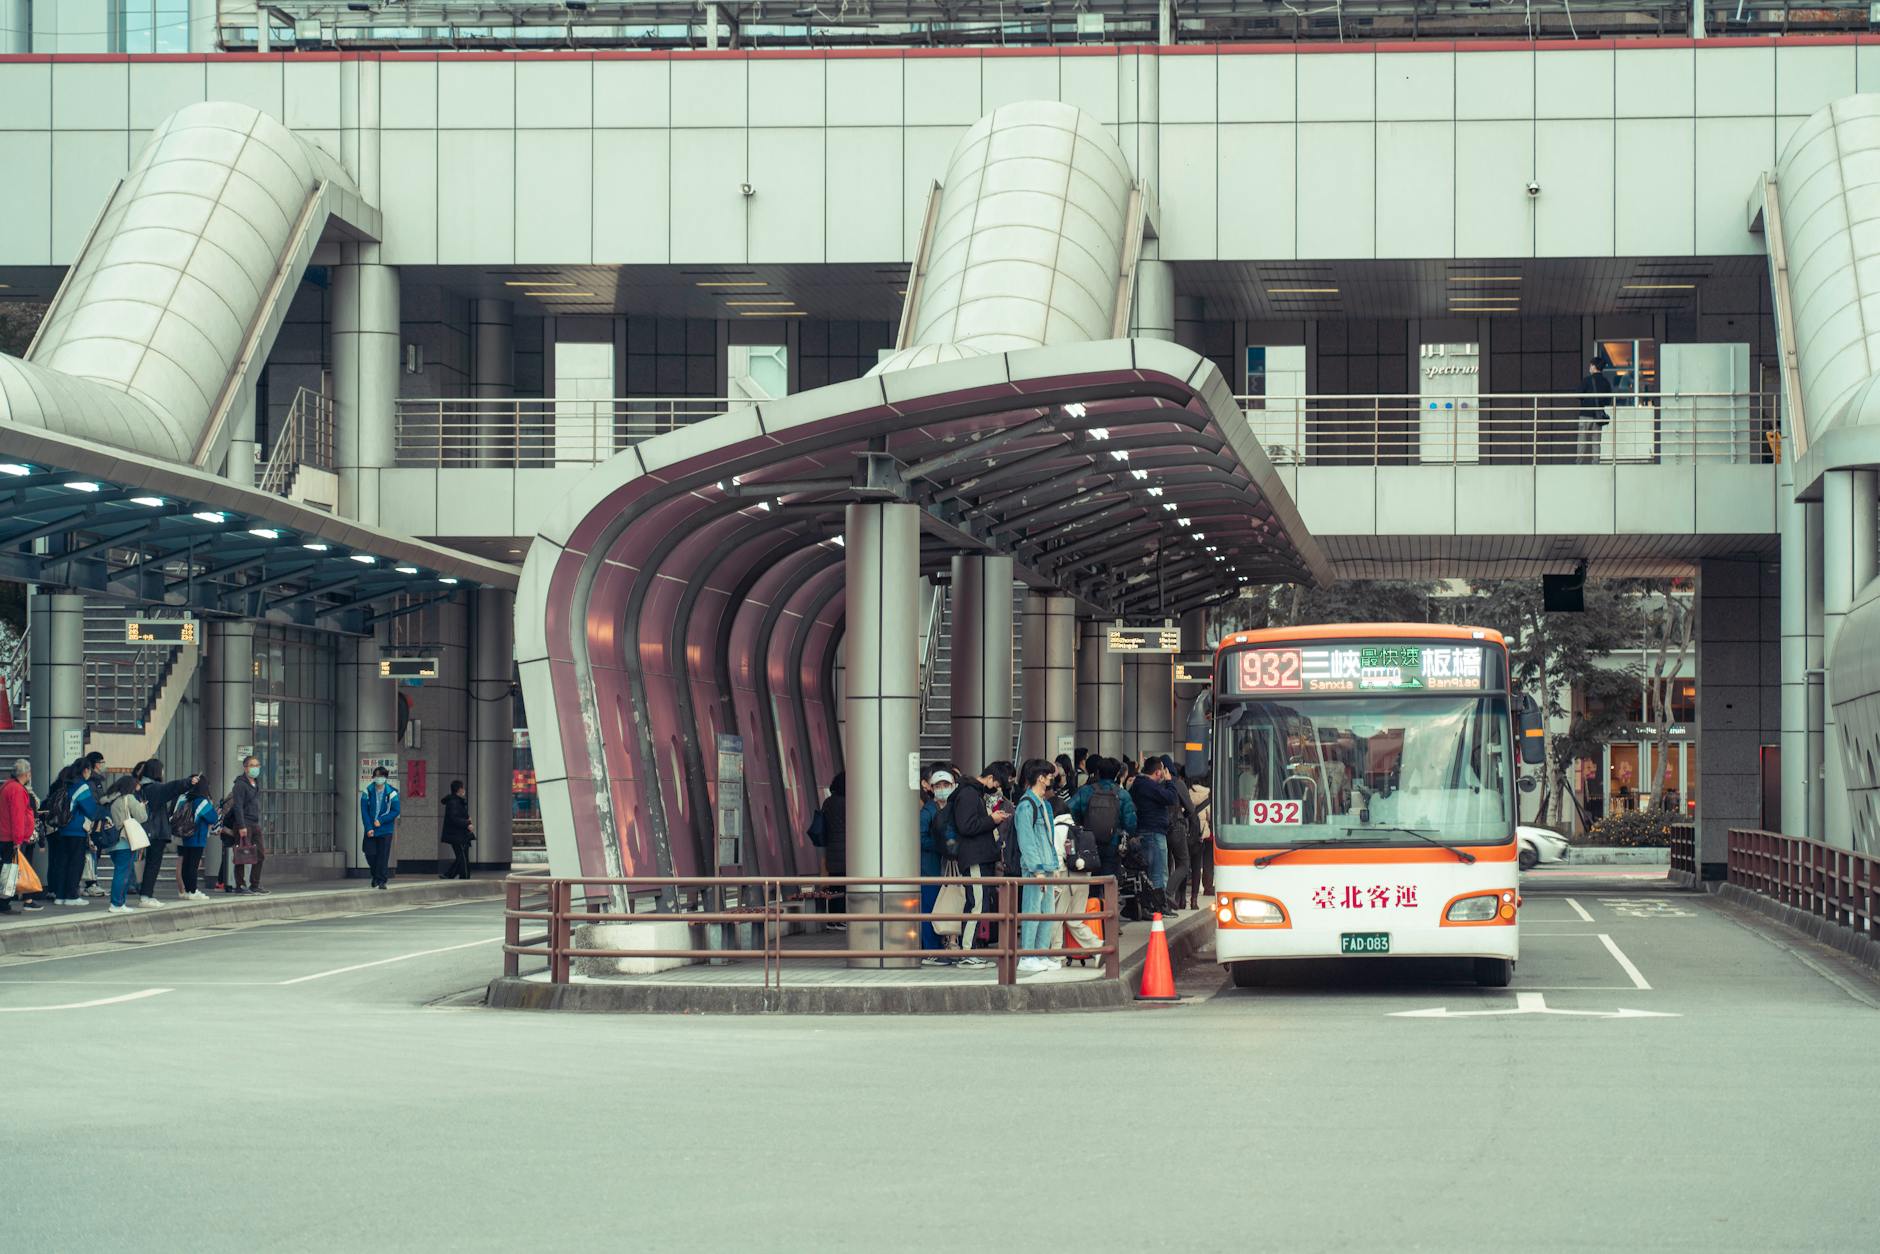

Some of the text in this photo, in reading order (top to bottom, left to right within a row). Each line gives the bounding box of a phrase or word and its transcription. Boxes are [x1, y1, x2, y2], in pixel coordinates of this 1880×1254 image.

[1302, 649, 1360, 678] 三峽
[1361, 646, 1420, 667] 最快速
[1421, 647, 1480, 677] 板橋
[1243, 652, 1299, 687] 932
[1310, 679, 1354, 690] Sanxia
[1428, 677, 1479, 688] Banqiao
[1253, 802, 1299, 824] 932
[1312, 885, 1418, 909] 臺北客運
[1342, 937, 1388, 951] FAD-083
